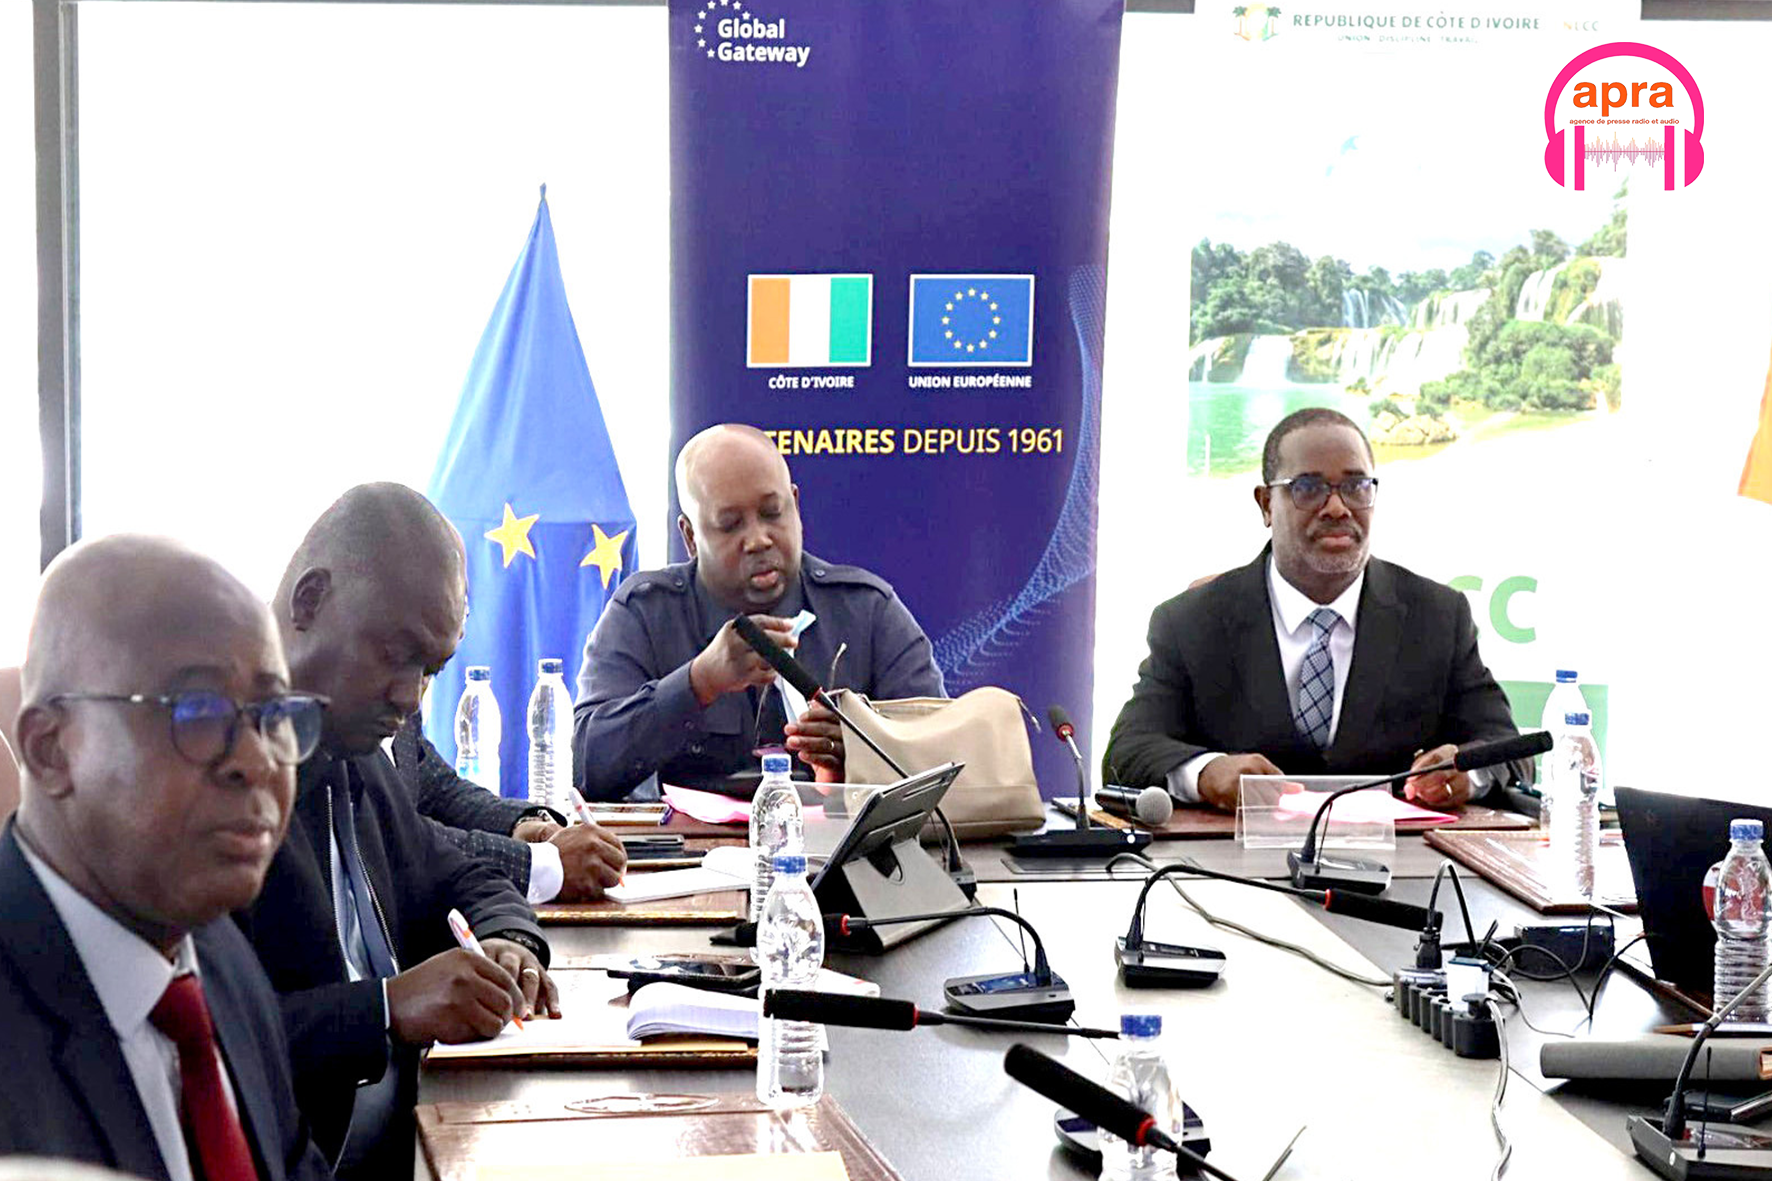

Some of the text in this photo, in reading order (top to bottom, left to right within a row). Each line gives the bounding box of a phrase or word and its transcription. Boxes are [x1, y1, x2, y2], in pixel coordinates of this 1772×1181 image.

[718, 18, 785, 39] Global
[1402, 16, 1422, 27] DE
[718, 42, 811, 67] Gateway
[768, 374, 854, 389] CÔTE D'IVOIRE
[908, 373, 1032, 388] UNION EUROPÉENNE
[903, 428, 1001, 454] DEPUIS
[1007, 428, 1064, 453] 1961
[1448, 575, 1538, 644] C
